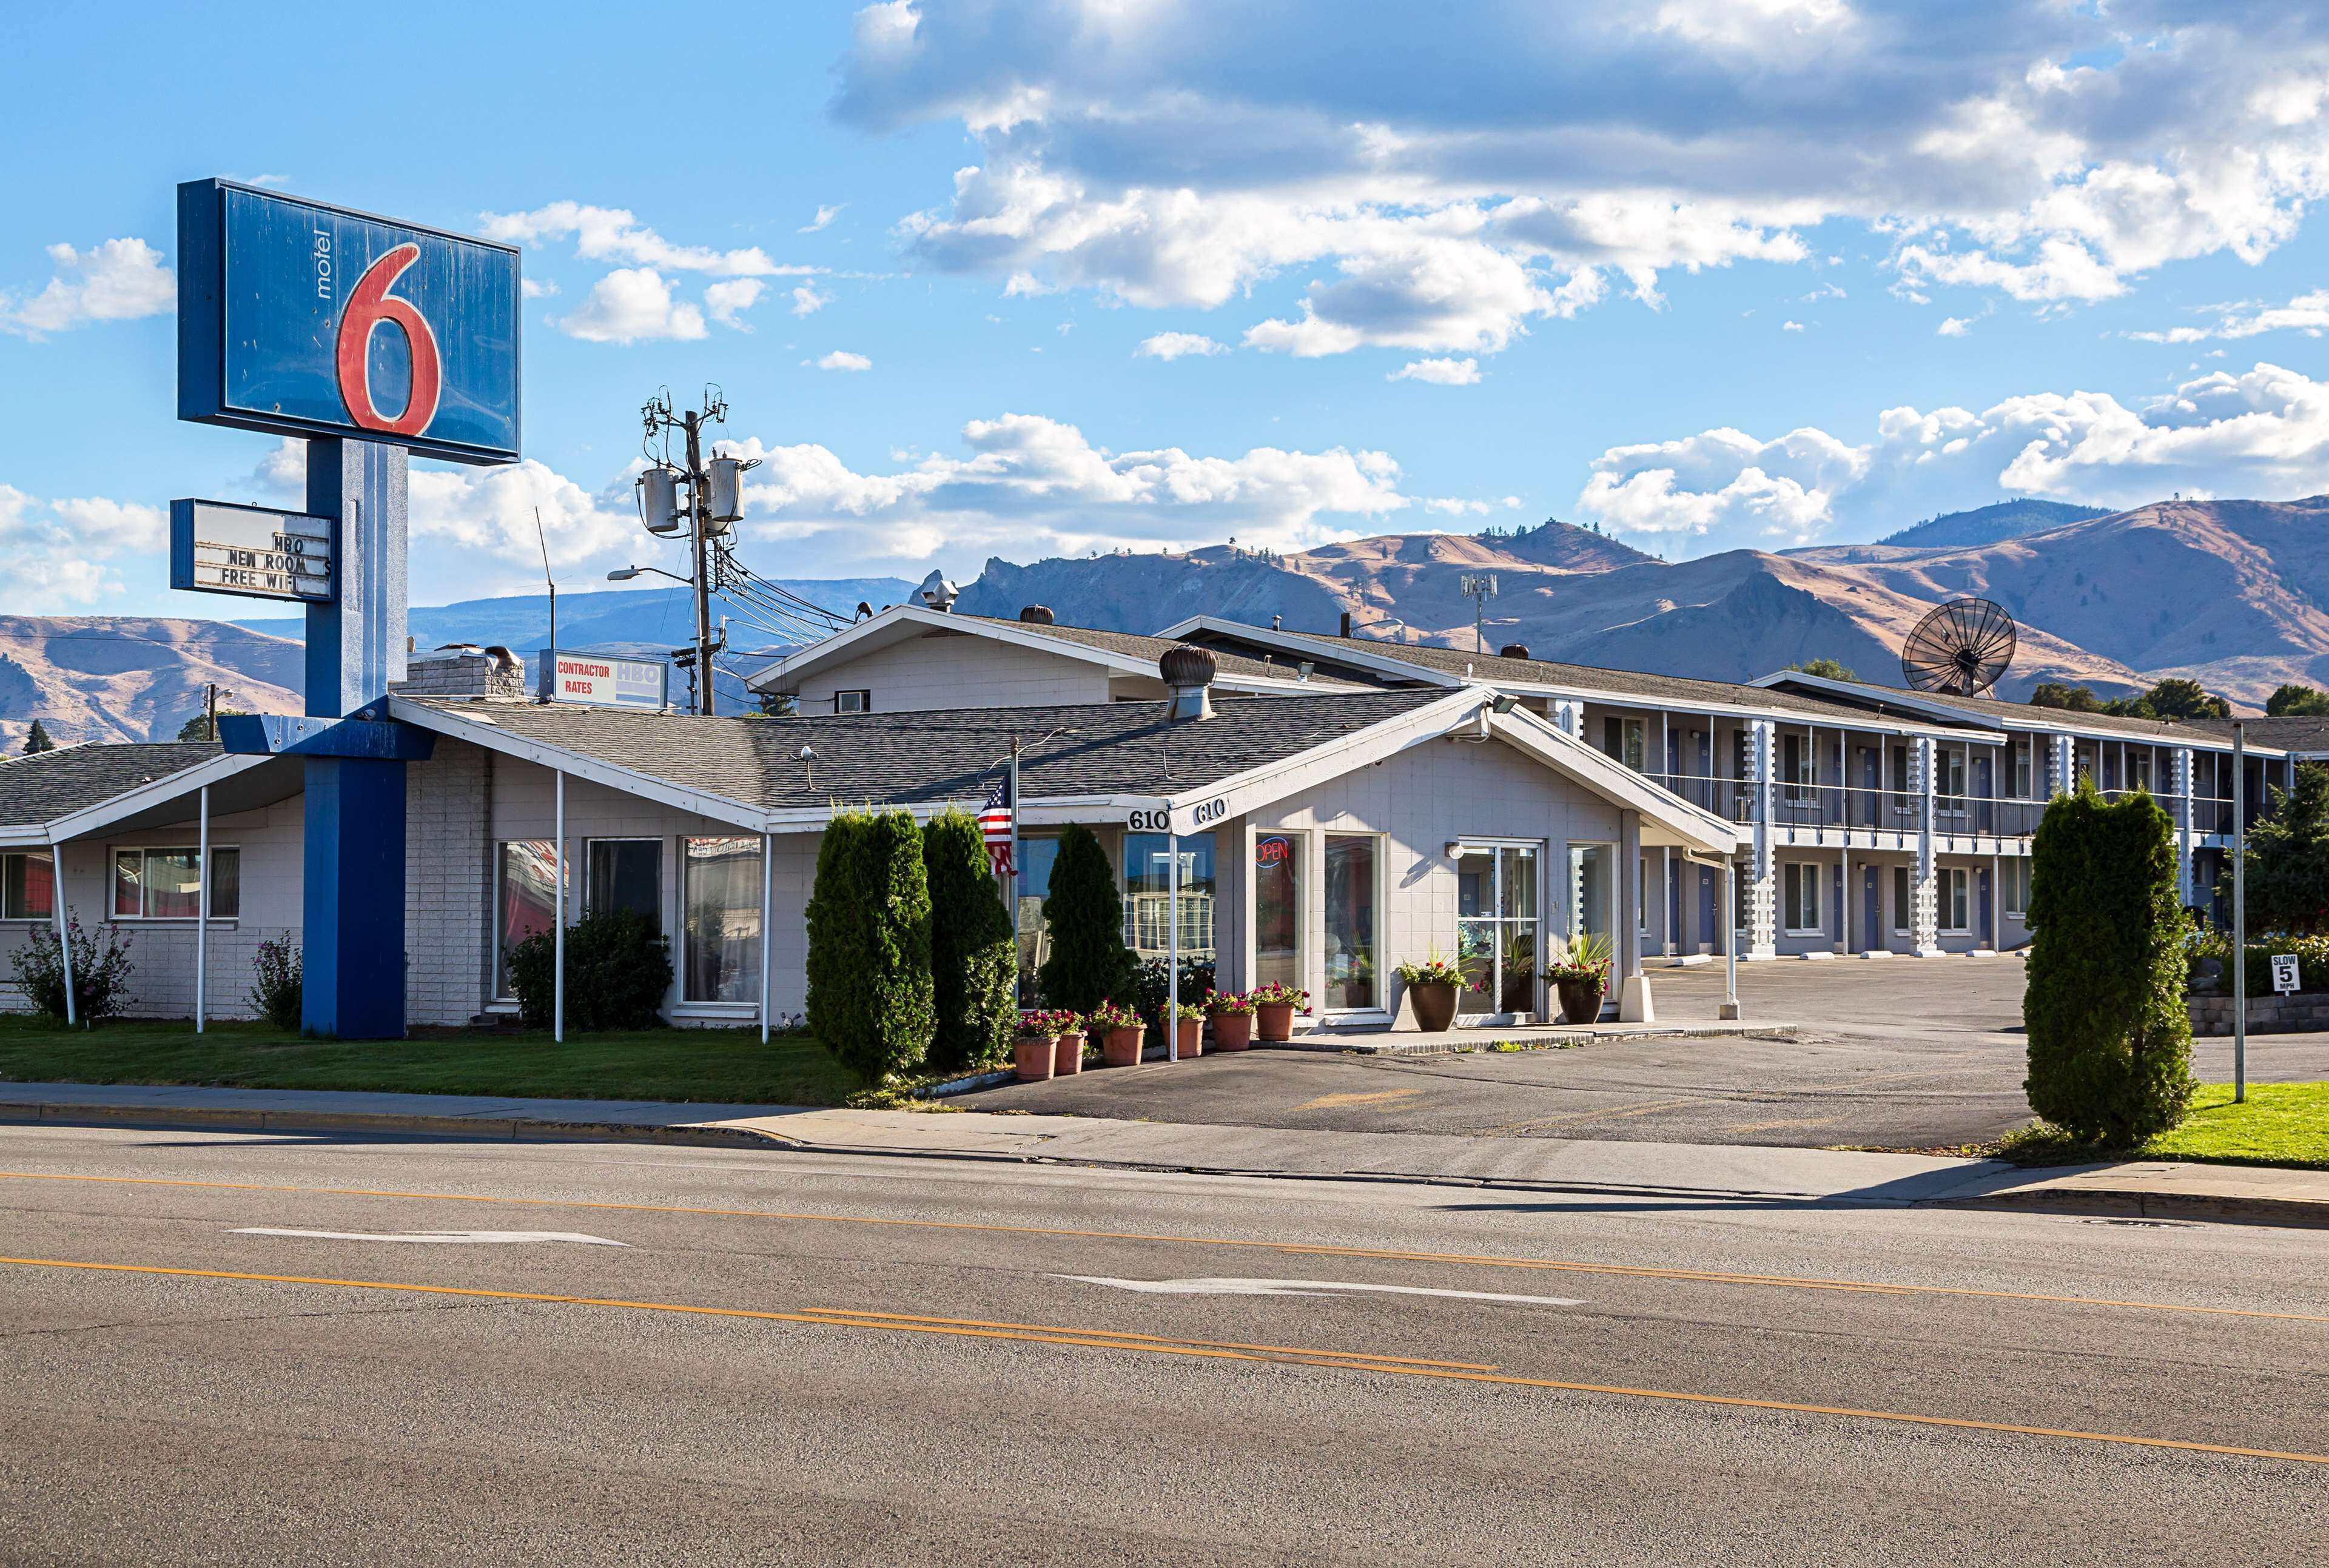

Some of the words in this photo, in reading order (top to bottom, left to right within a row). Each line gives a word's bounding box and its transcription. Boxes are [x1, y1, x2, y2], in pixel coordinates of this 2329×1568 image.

[314, 230, 331, 300] motel
[335, 243, 441, 436] 6
[275, 536, 303, 554] HBO
[229, 550, 256, 568] NEW
[266, 554, 306, 573] ROOM
[222, 569, 256, 585] FREE
[267, 574, 297, 591] WIFI
[558, 661, 610, 678] CONTRACTOR
[617, 663, 659, 683] HBO
[565, 680, 592, 694] RATES
[1129, 810, 1169, 830] 610
[1195, 798, 1225, 823] 610
[1255, 842, 1288, 862] OPEN
[2273, 956, 2296, 965] SLOW
[2279, 966, 2292, 982] 5
